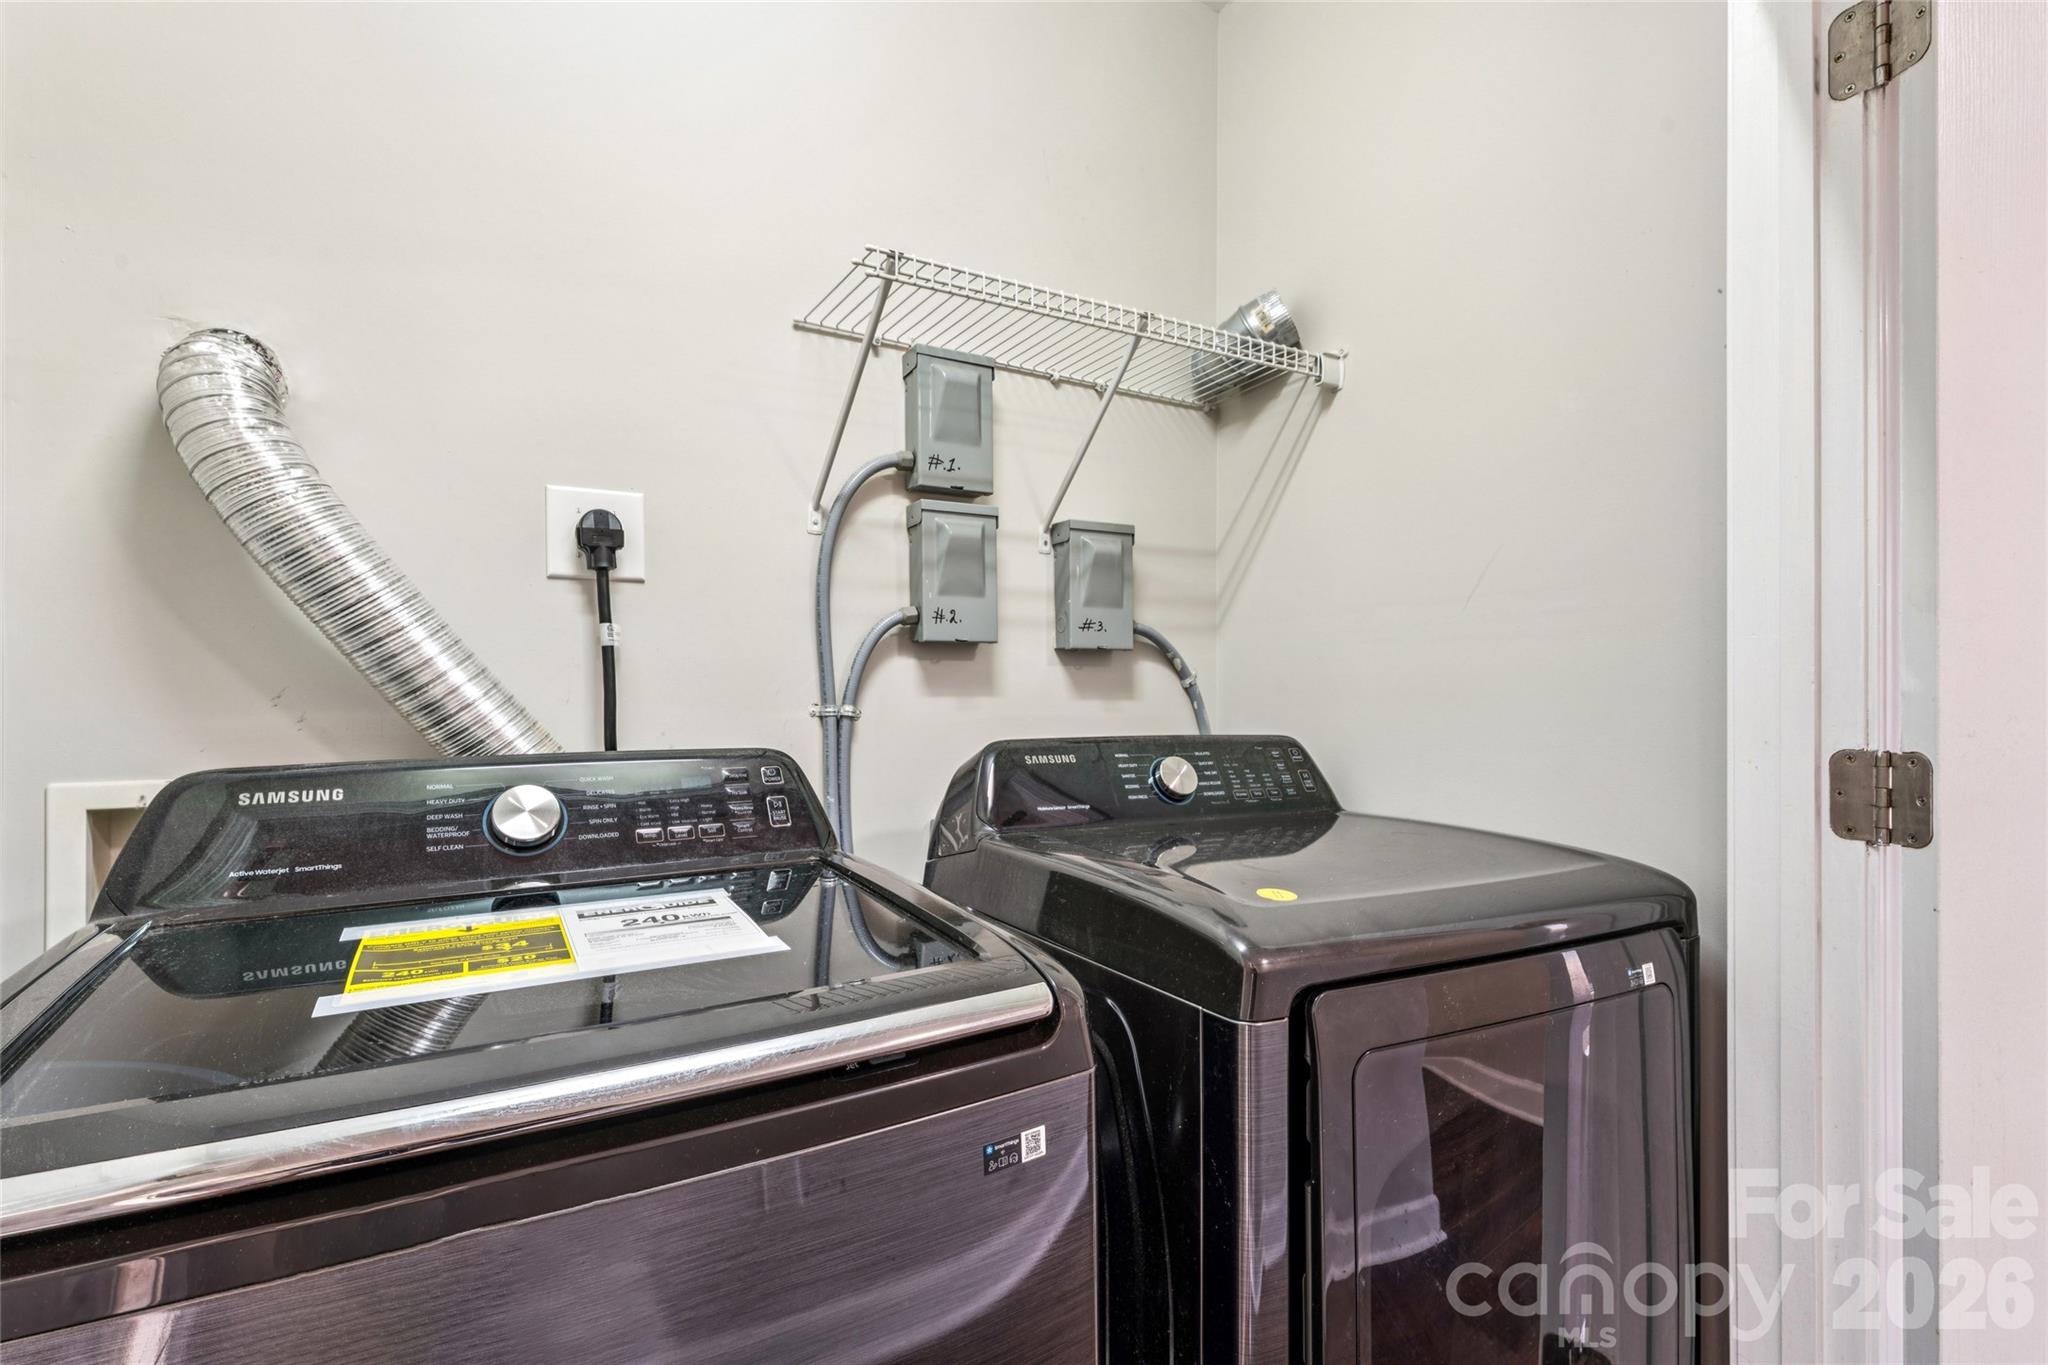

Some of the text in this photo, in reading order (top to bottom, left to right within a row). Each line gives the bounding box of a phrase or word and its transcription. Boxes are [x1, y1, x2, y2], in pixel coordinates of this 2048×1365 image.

[1024, 754, 1077, 765] SAMSUNG
[237, 788, 345, 807] SAMSUNG
[426, 825, 459, 833] BEDDING/
[426, 831, 470, 839] WATERPROOF
[578, 832, 620, 840] DOWNLOADED
[228, 870, 255, 878] Active
[294, 863, 343, 873] SmartThings
[620, 913, 680, 928] 240
[481, 940, 529, 952] $34
[382, 969, 424, 979] 240
